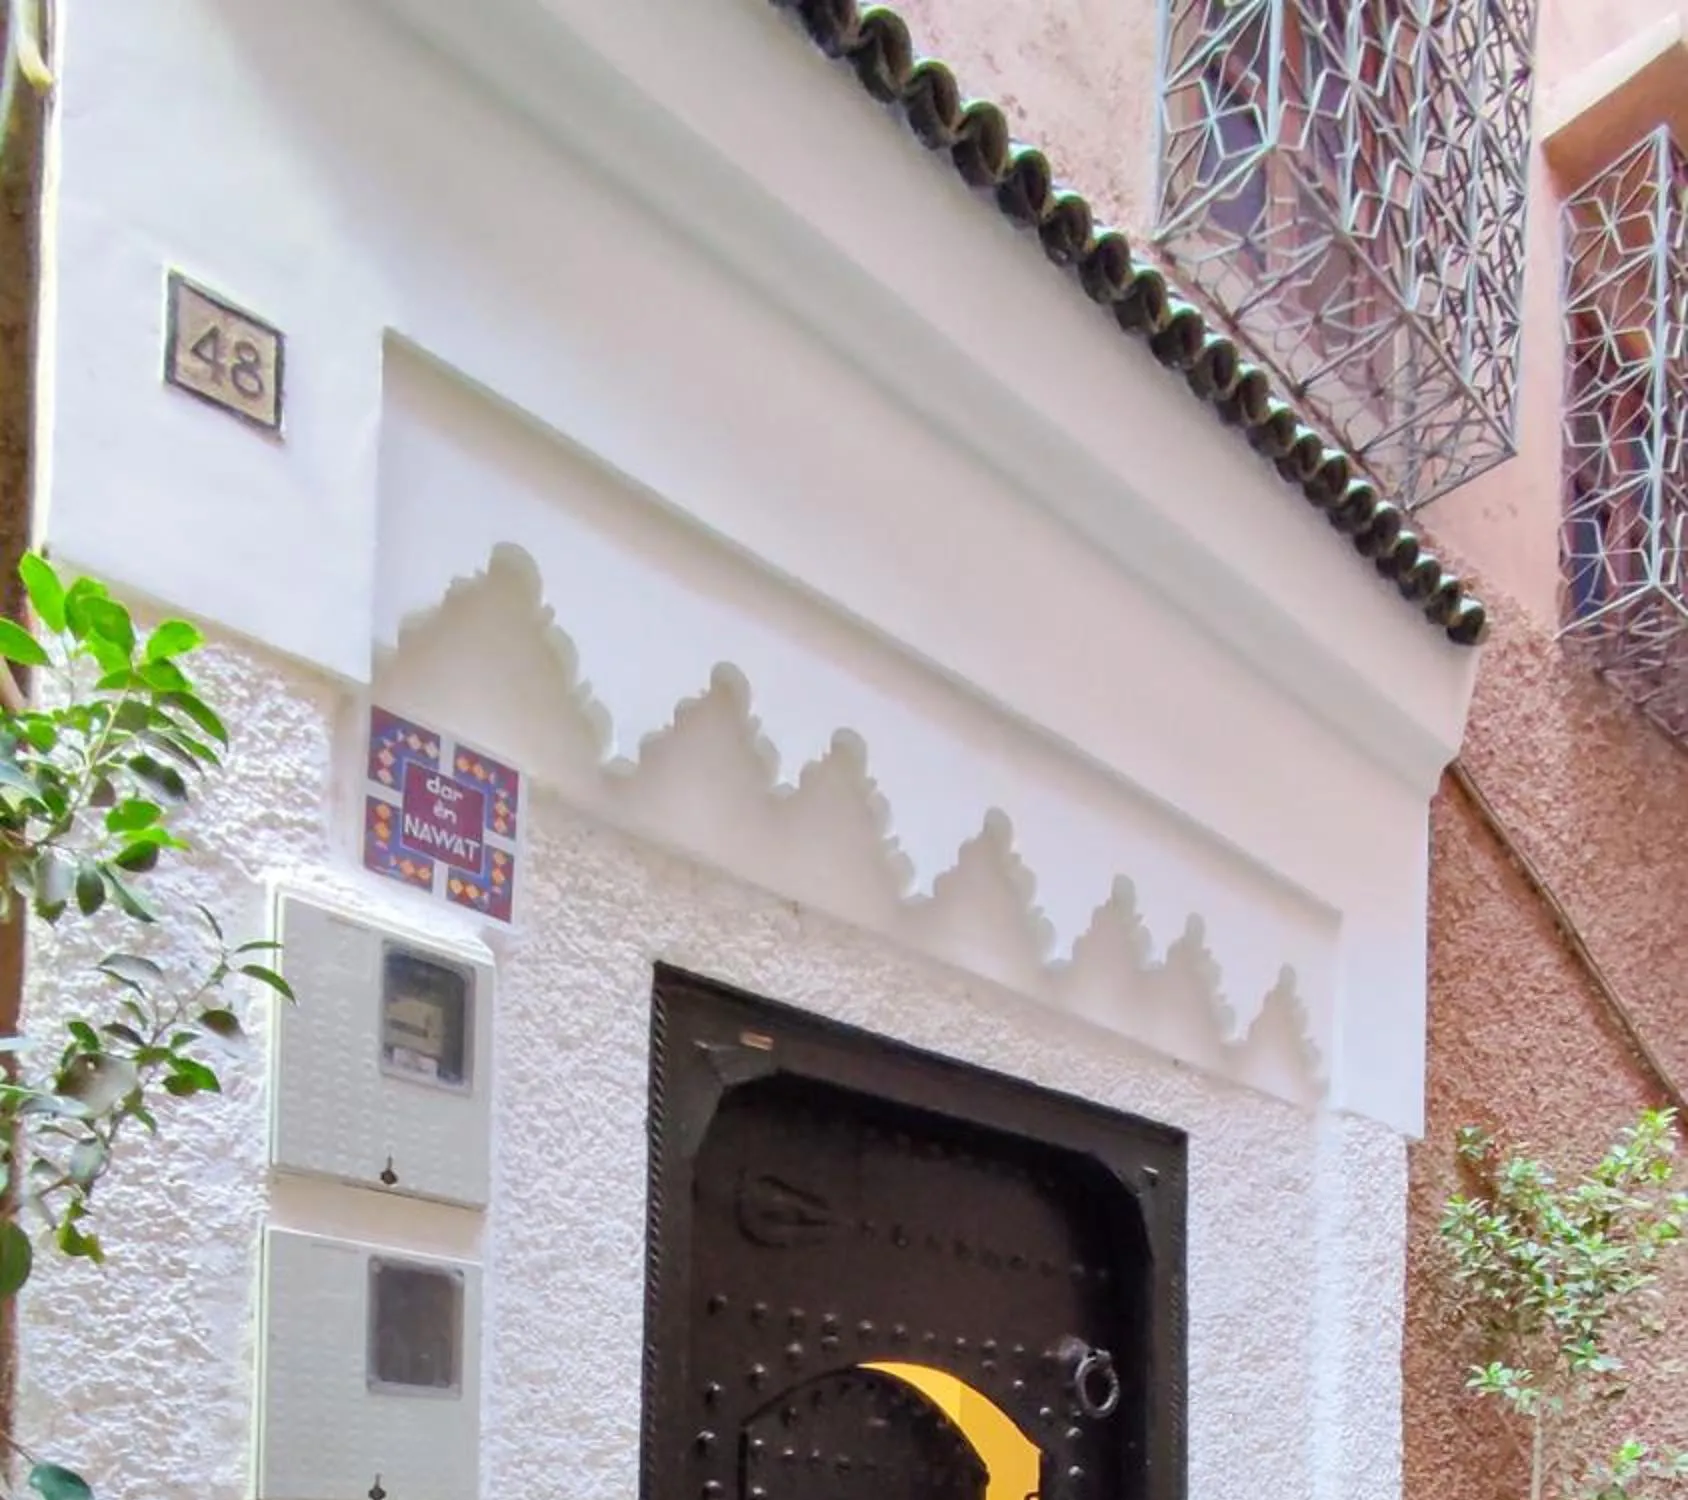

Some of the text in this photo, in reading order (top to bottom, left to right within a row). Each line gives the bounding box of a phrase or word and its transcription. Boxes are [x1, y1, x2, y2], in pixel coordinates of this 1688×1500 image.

[190, 325, 264, 399] 48
[426, 776, 463, 801] dar
[404, 814, 480, 861] NAWAT
